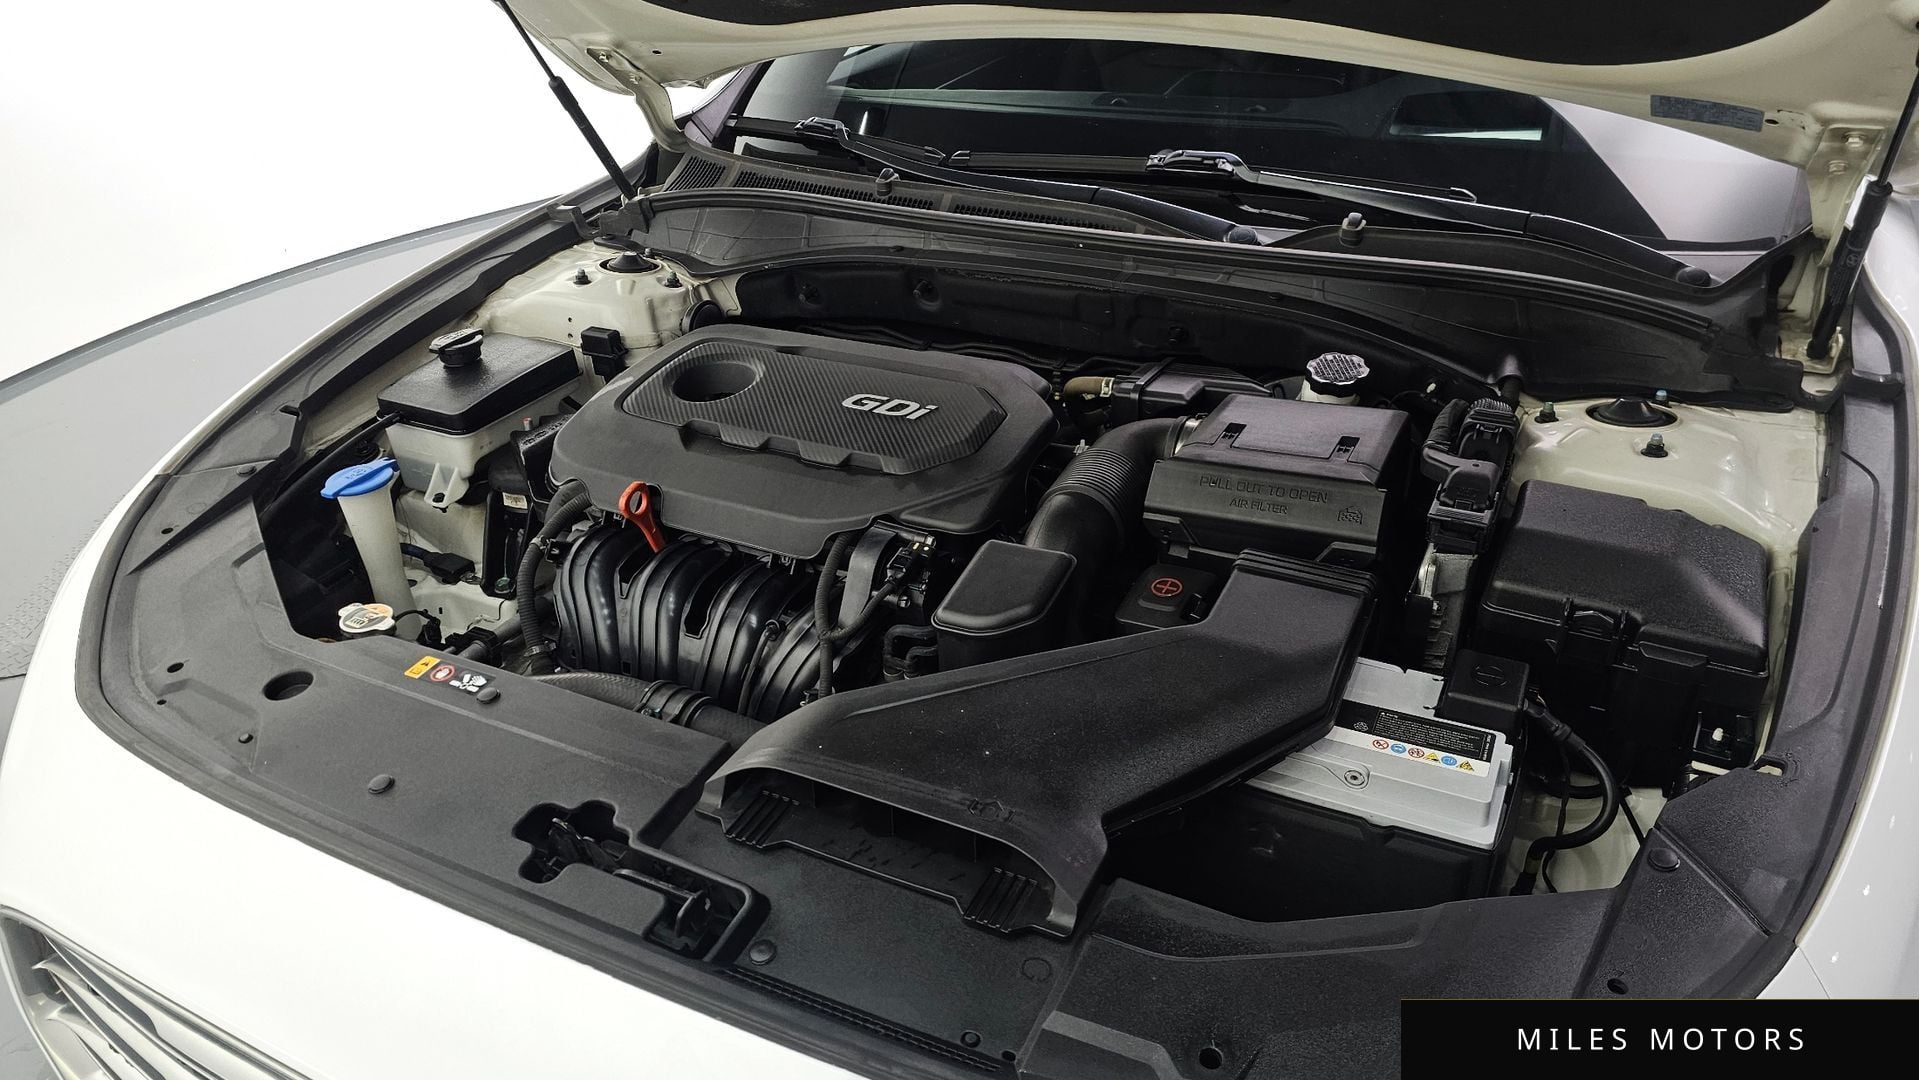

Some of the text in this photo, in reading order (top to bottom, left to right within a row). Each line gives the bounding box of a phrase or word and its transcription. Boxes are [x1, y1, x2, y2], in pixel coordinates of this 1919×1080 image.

[841, 393, 939, 420] GDi
[1200, 475, 1328, 503] PULL OUT TO OPEN
[1229, 497, 1288, 515] AIR FILTER
